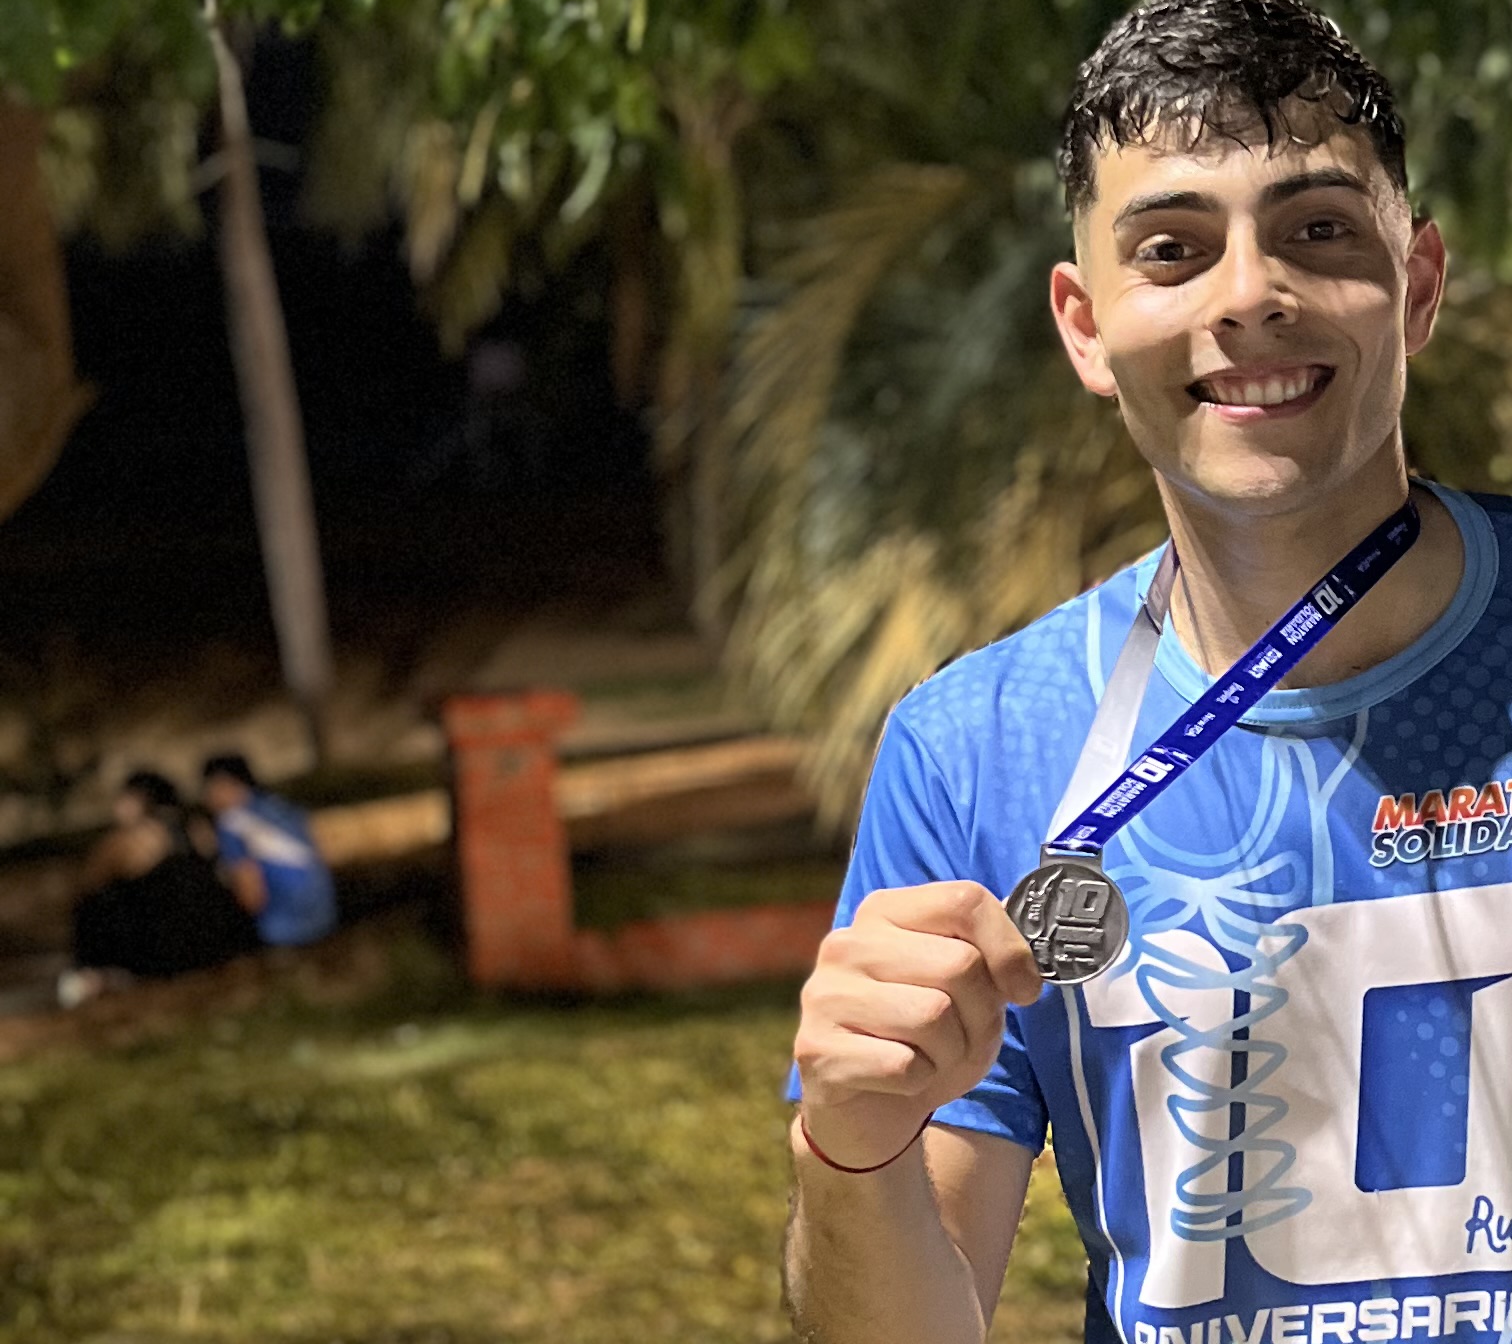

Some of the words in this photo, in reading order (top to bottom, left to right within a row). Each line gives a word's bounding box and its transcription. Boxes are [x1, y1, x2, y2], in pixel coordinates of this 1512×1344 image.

[1314, 583, 1344, 616] 10
[1133, 755, 1175, 783] 10
[1057, 879, 1110, 920] 10
